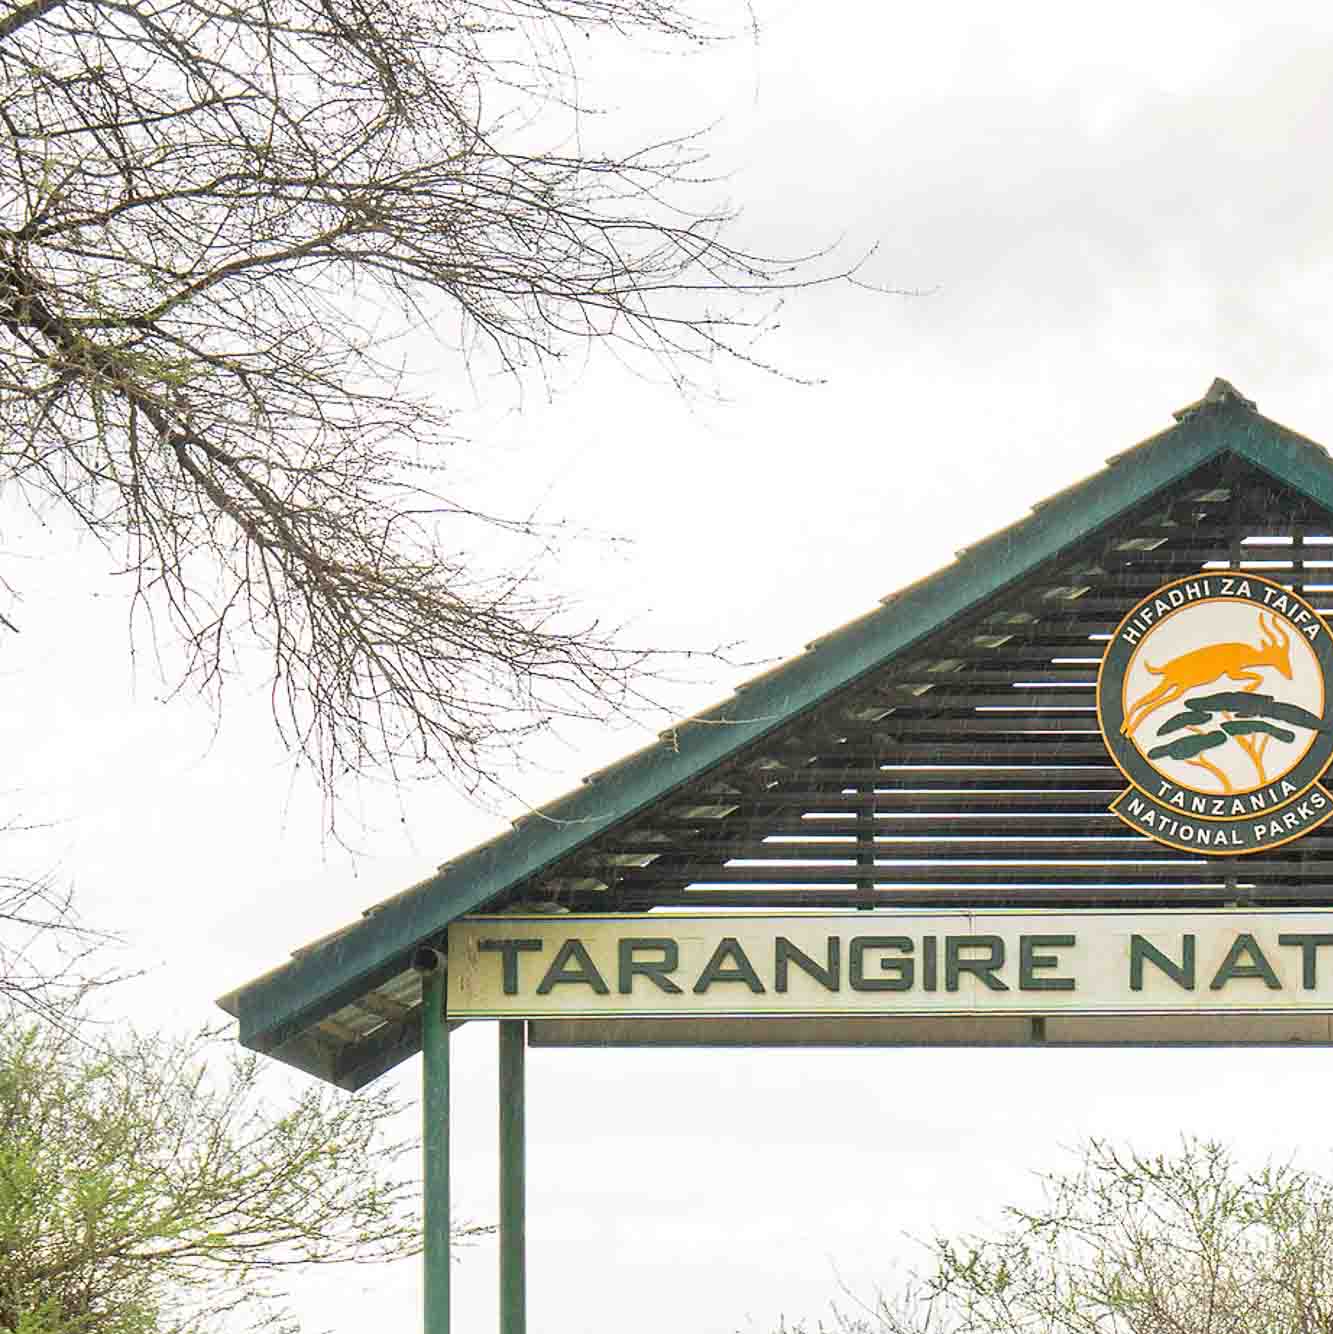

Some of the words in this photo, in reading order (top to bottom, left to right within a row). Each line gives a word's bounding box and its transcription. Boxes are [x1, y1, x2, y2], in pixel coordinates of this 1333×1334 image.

[1122, 581, 1210, 645] HIFADHI
[1220, 578, 1252, 597] ZA
[1263, 586, 1322, 641] TAIFA
[1127, 797, 1243, 845] NATIONAL
[1254, 792, 1326, 841] PARKS
[1156, 780, 1297, 816] TANZANIA
[478, 934, 1076, 995] TARANGIRE
